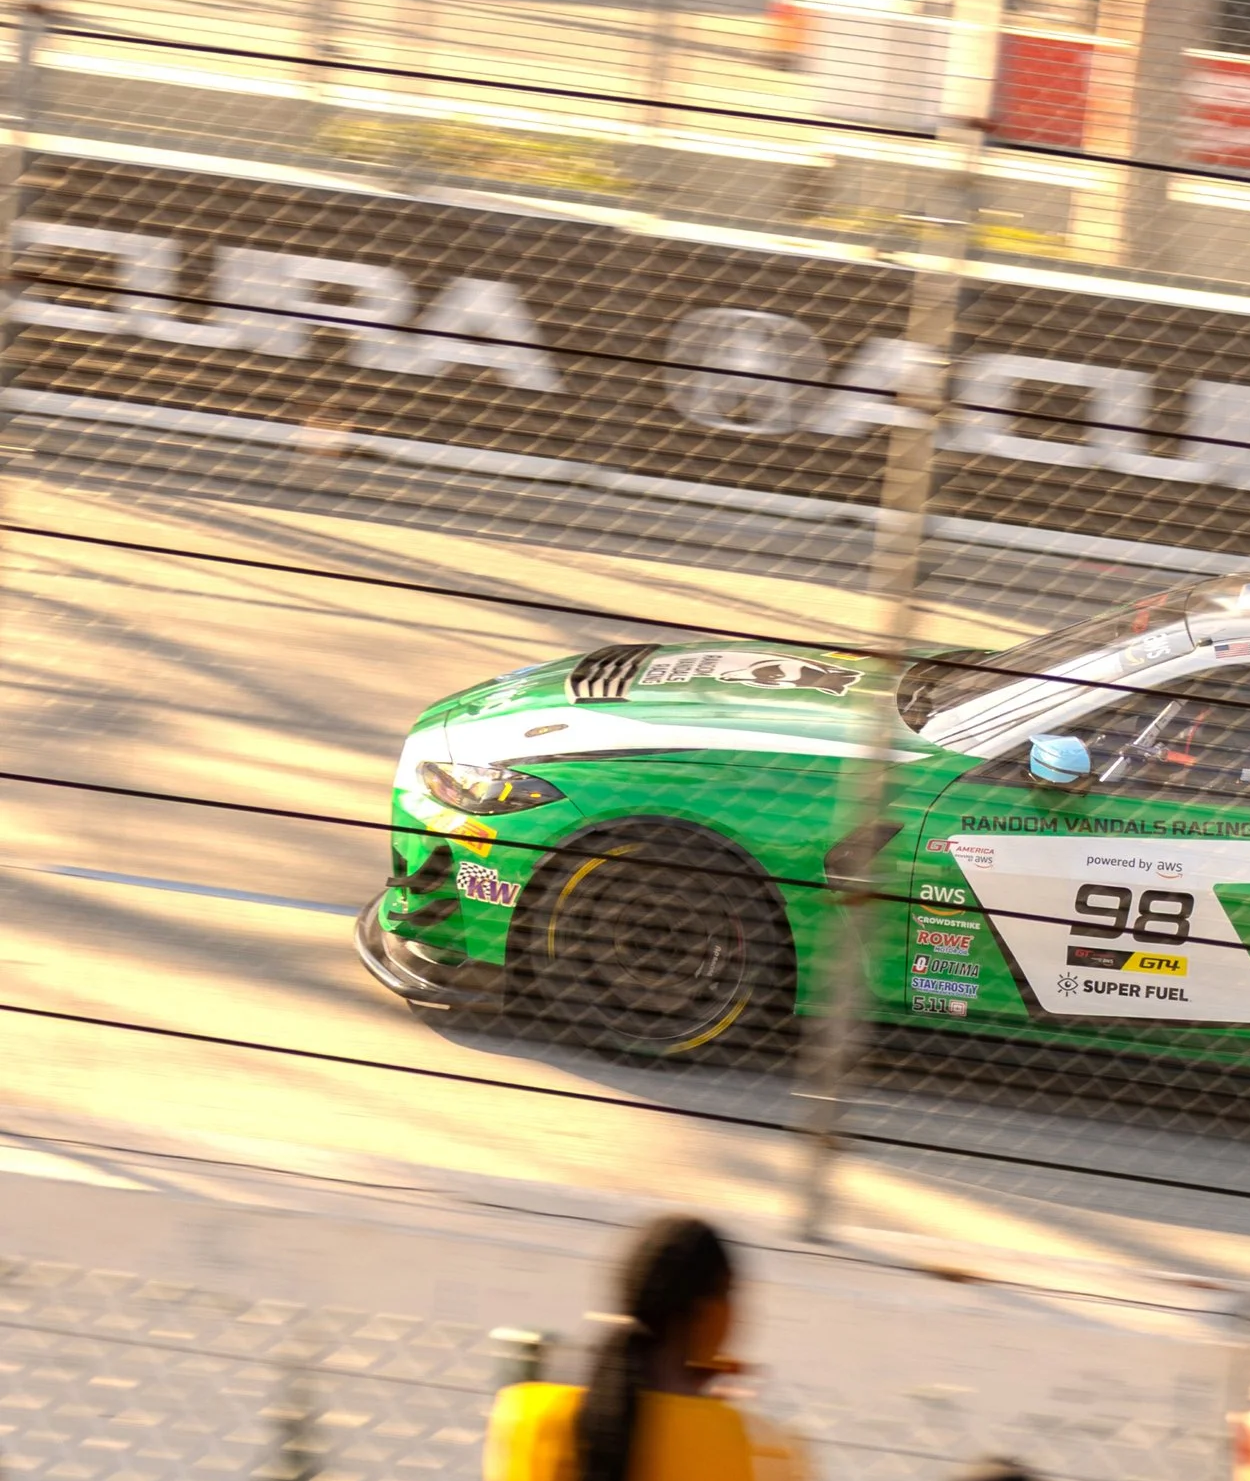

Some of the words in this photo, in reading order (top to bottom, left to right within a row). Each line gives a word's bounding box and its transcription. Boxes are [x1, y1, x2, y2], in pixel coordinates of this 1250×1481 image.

[962, 816, 1058, 833] RANDOM
[1064, 818, 1168, 836] VANDALS
[926, 839, 959, 853] GT
[956, 845, 995, 855] AMERICA
[975, 856, 993, 864] aws
[1086, 855, 1136, 868] powered
[1139, 859, 1153, 872] by
[1157, 861, 1183, 872] aws
[466, 876, 521, 908] KW
[919, 884, 966, 905] aws
[917, 916, 981, 930] CROWDSTRIKE
[1070, 883, 1195, 946] 98
[917, 930, 971, 949] ROWE
[931, 959, 980, 977] OPTIMA
[1139, 957, 1180, 971] GT4
[912, 977, 937, 989] STAY
[939, 981, 978, 995] FROSTY
[1083, 980, 1141, 998] SUPER
[1145, 985, 1189, 1002] FUEL
[912, 996, 946, 1014] 5.11
